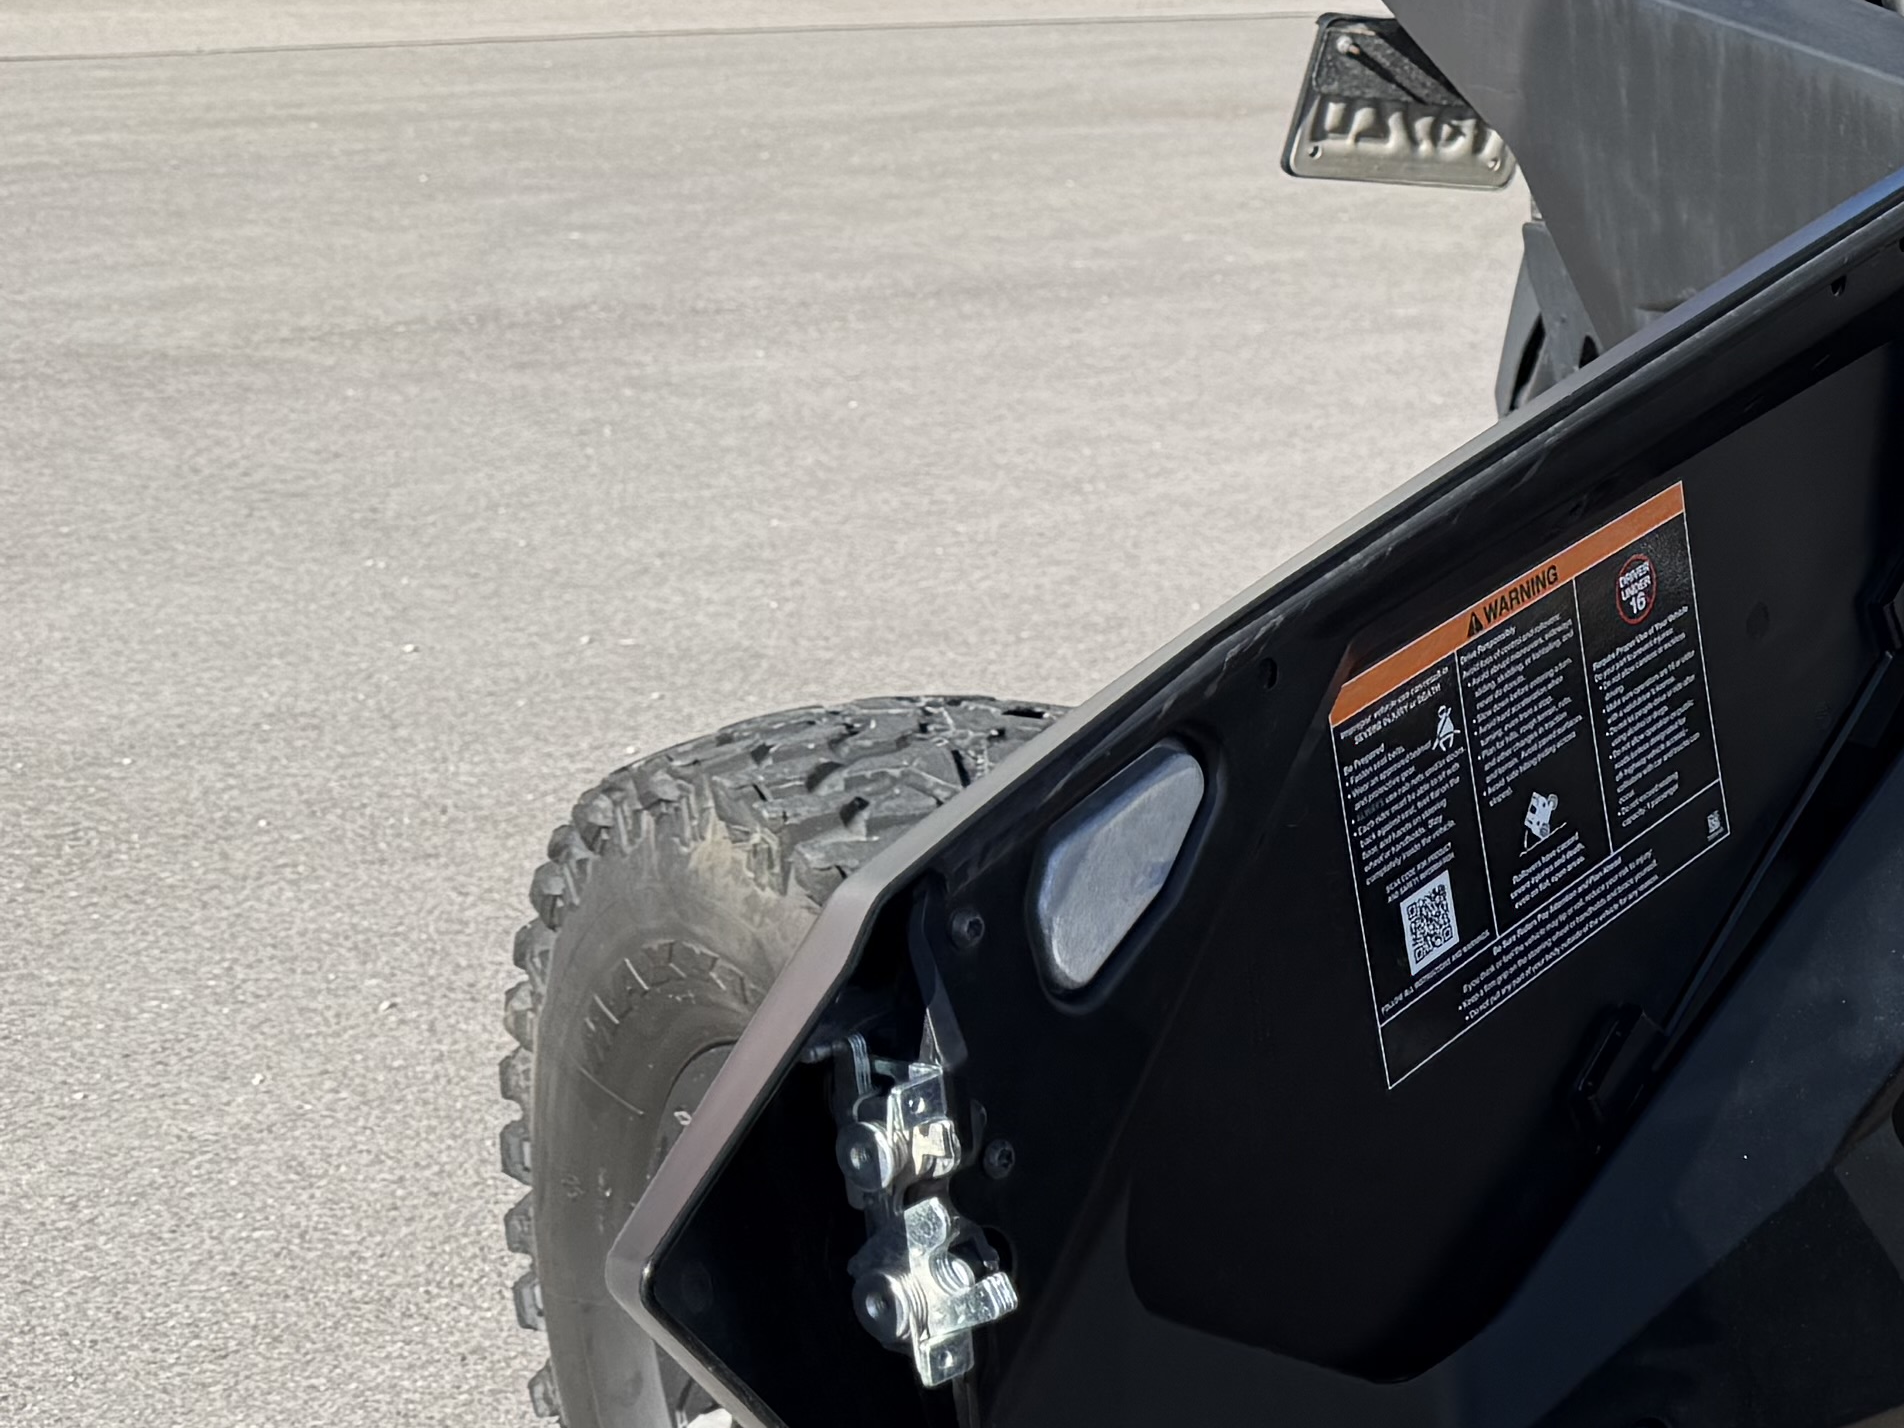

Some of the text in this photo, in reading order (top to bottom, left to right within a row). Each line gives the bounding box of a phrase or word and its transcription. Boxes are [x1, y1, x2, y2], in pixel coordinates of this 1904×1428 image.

[1618, 559, 1650, 588] DRIVER
[1621, 574, 1651, 601] UNDER
[1483, 565, 1558, 624] WARNING
[1629, 591, 1646, 614] 16
